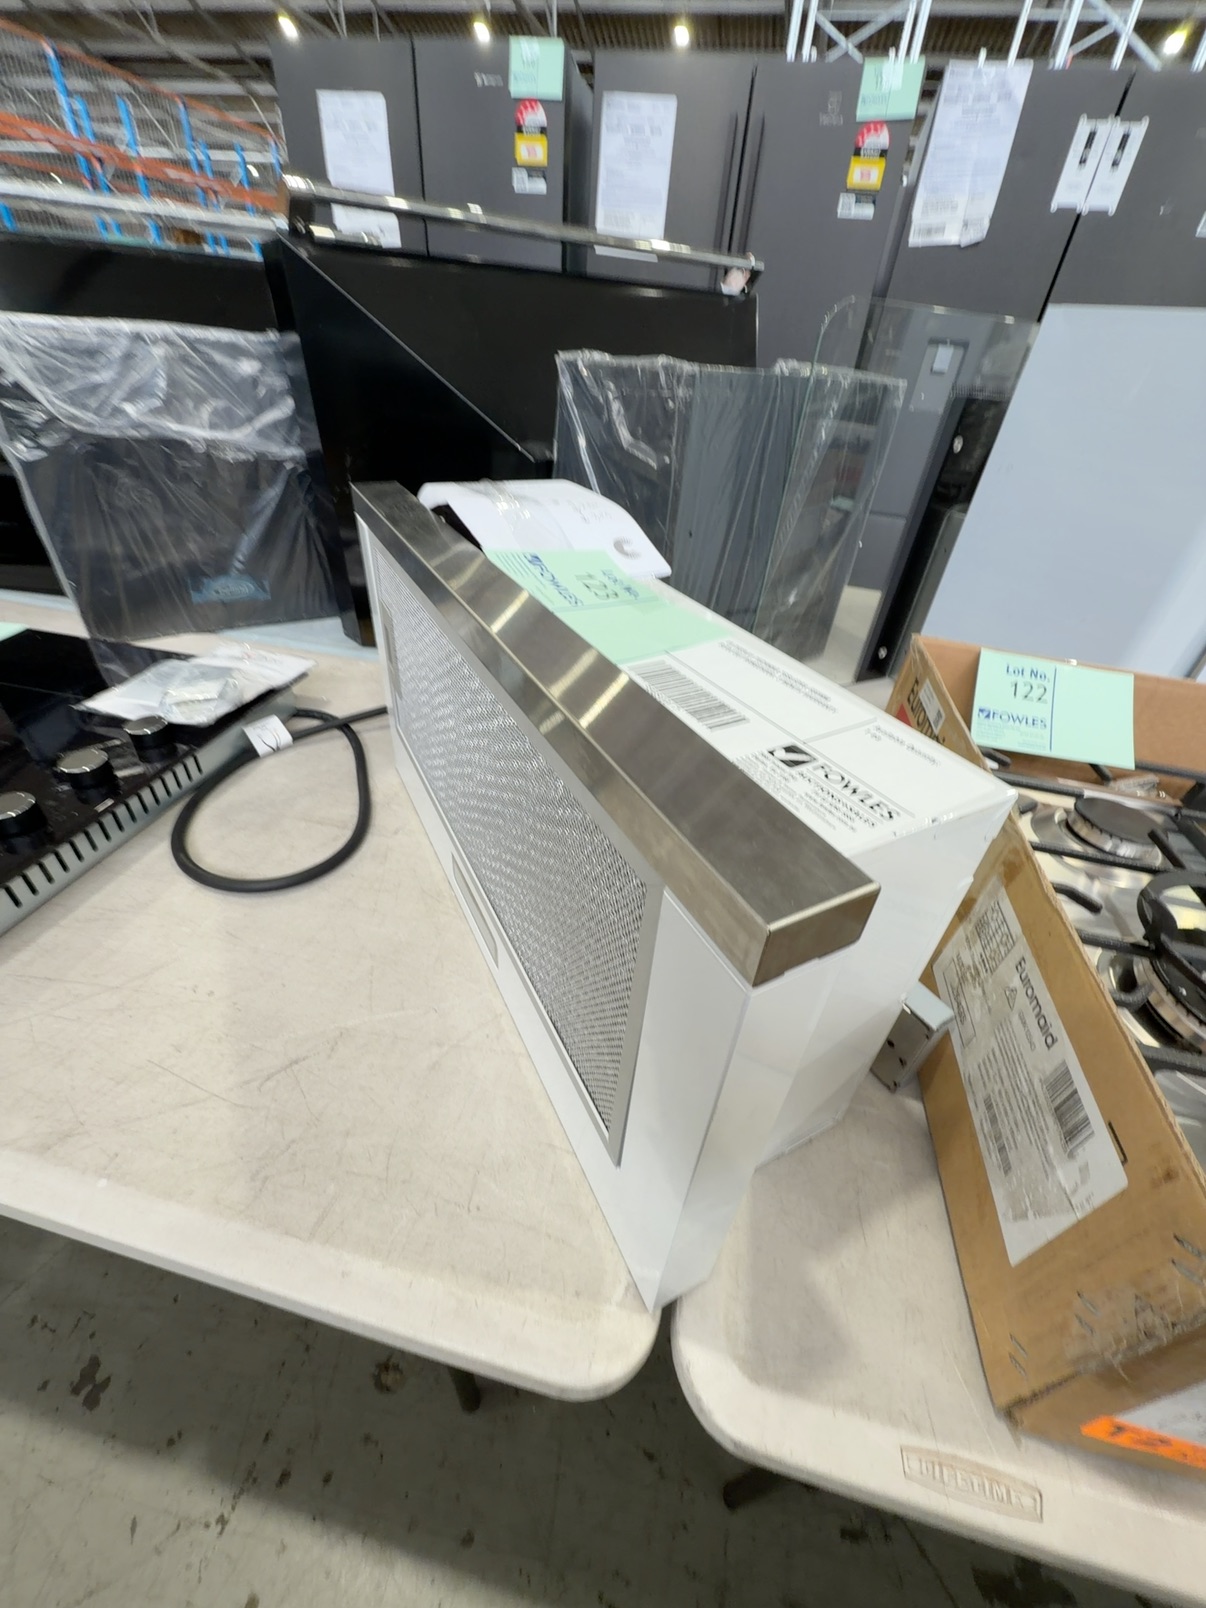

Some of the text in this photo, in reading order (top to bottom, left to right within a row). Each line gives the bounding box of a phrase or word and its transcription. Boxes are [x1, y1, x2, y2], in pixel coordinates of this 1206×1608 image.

[575, 571, 619, 601] 123
[1006, 664, 1050, 683] Lot No.
[1011, 681, 1048, 704] 122
[992, 711, 1047, 729] FOWLES
[813, 763, 900, 821] FOWLES
[1016, 957, 1057, 1051] Euromaid
